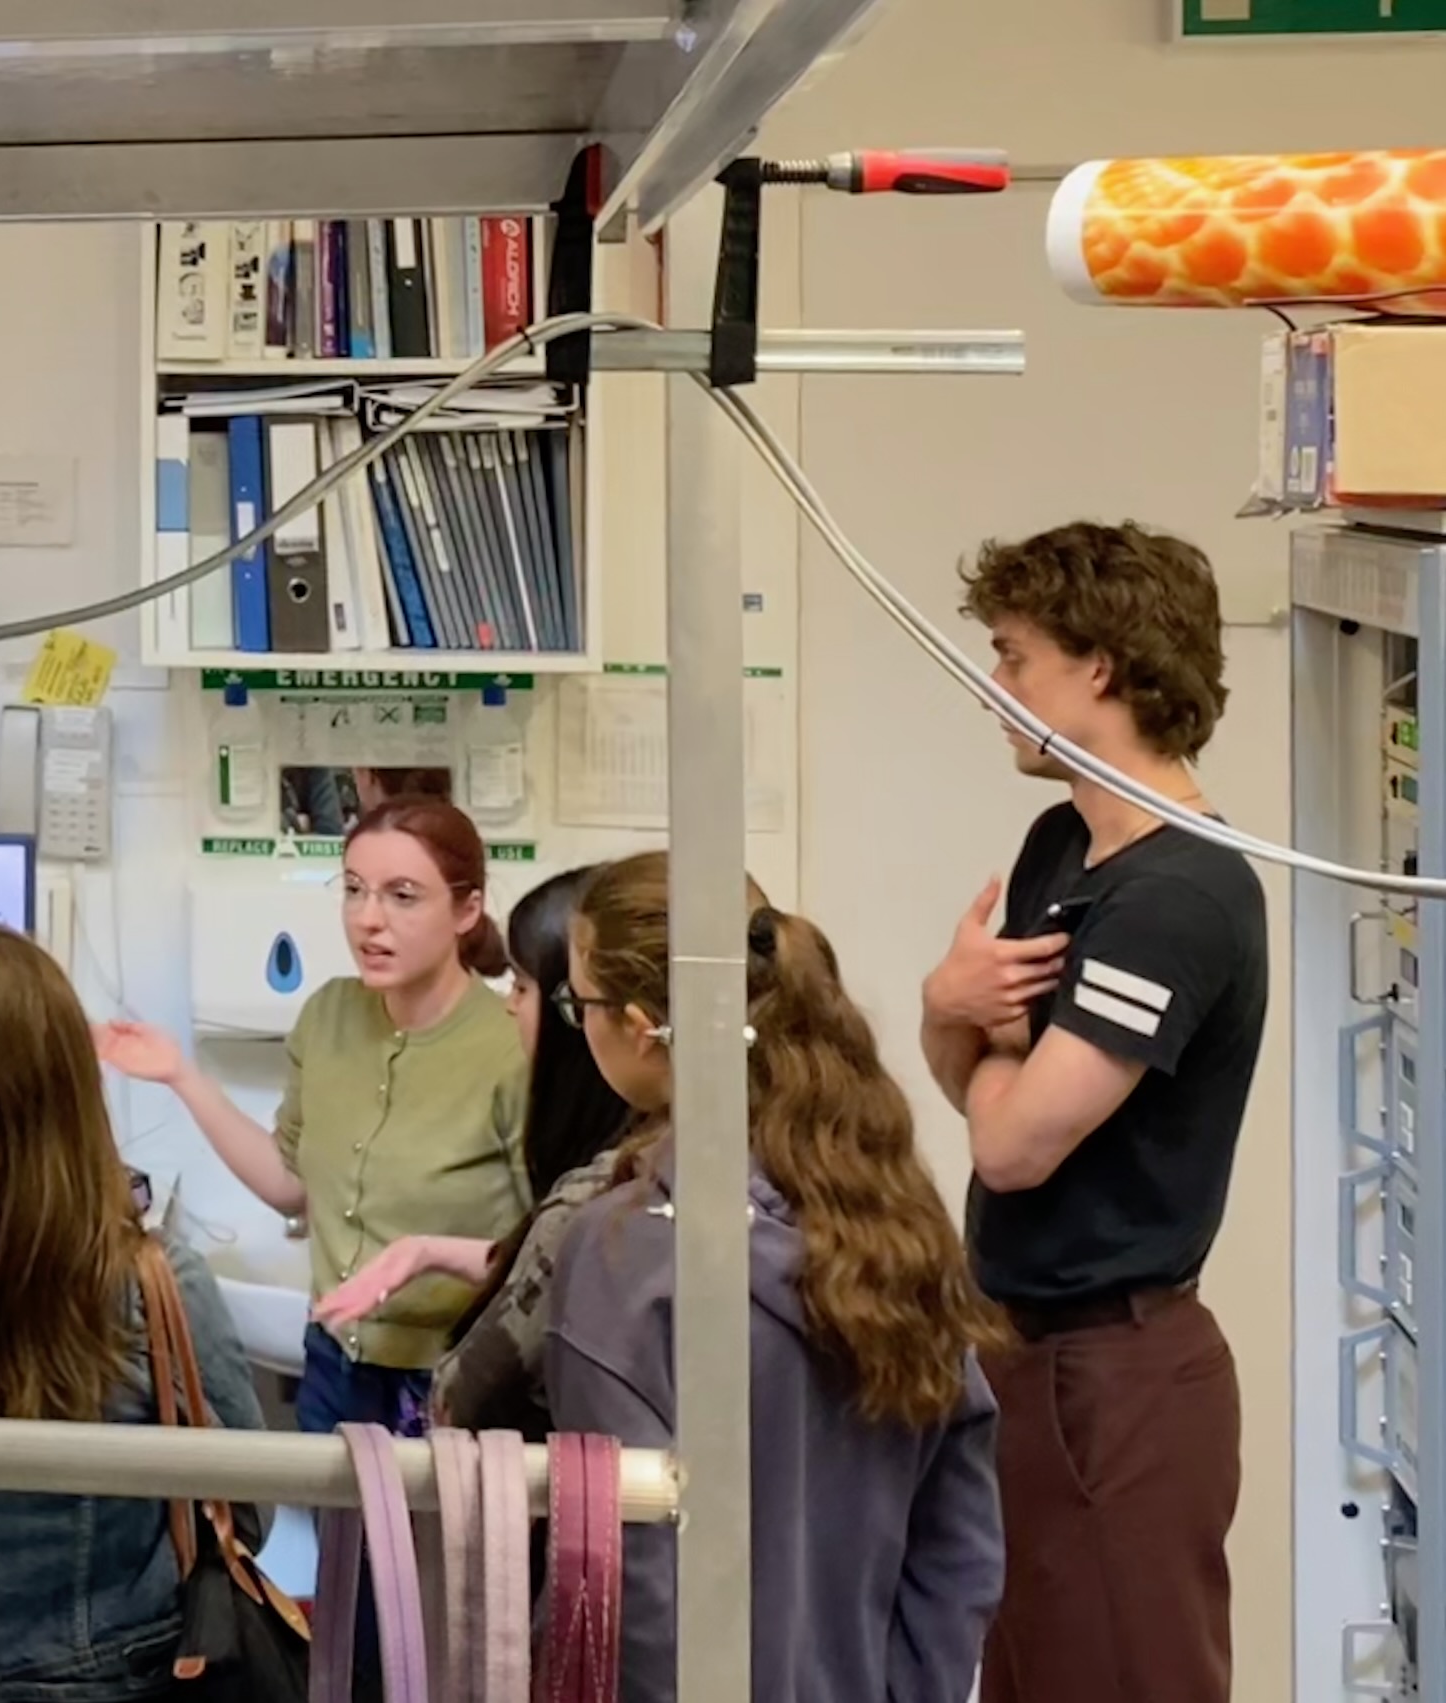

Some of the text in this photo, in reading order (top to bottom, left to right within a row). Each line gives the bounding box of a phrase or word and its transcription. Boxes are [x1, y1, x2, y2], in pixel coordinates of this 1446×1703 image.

[276, 670, 459, 687] EMERGENCY
[212, 840, 269, 854] REPLACE
[497, 845, 523, 860] USE
